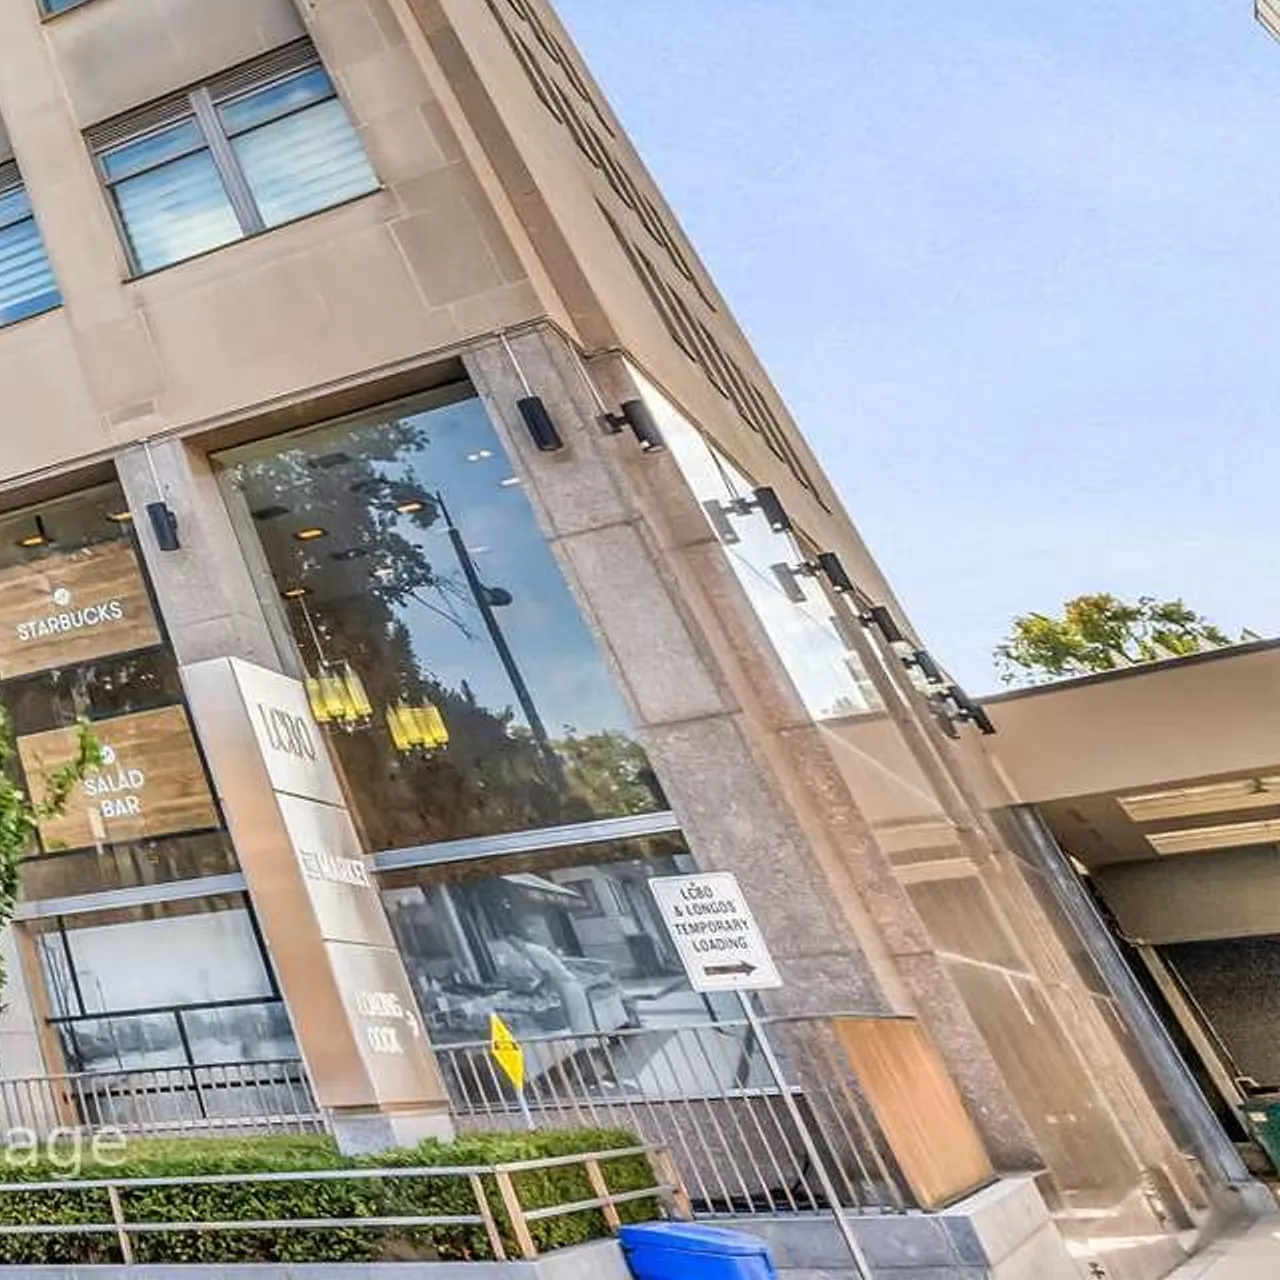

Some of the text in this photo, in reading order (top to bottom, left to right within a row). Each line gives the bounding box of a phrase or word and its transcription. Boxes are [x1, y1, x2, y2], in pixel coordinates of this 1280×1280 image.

[16, 600, 123, 642] STARBUCKS
[83, 769, 144, 798] SALAD
[101, 795, 141, 819] BAR
[672, 917, 750, 936] TEMPORARY
[691, 935, 748, 954] LOADING
